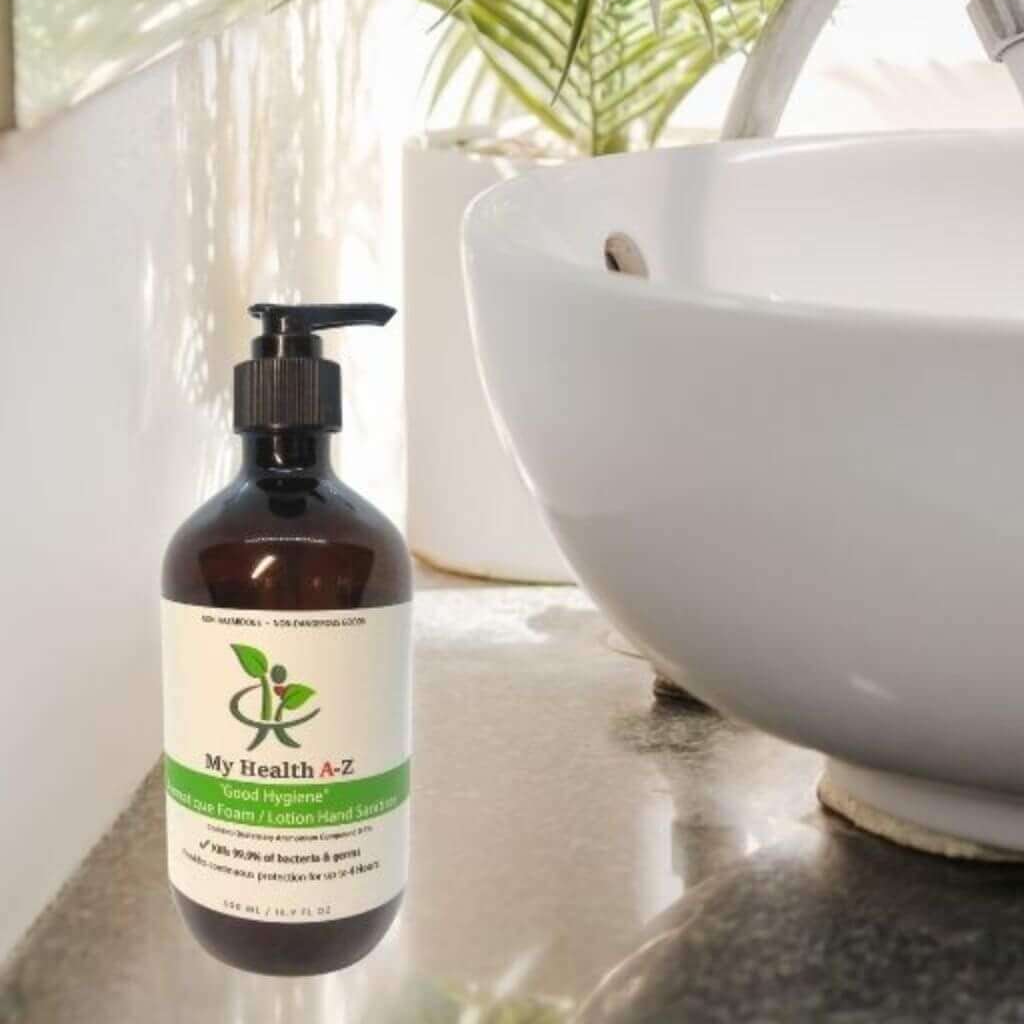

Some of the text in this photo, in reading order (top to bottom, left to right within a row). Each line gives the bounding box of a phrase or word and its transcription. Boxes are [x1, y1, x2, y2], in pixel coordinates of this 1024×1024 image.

[205, 753, 353, 779] My Health A-Z
[217, 802, 255, 821] Foam
[267, 810, 314, 825] Lotion
[318, 807, 352, 823] Hand
[277, 853, 320, 863] bacteria
